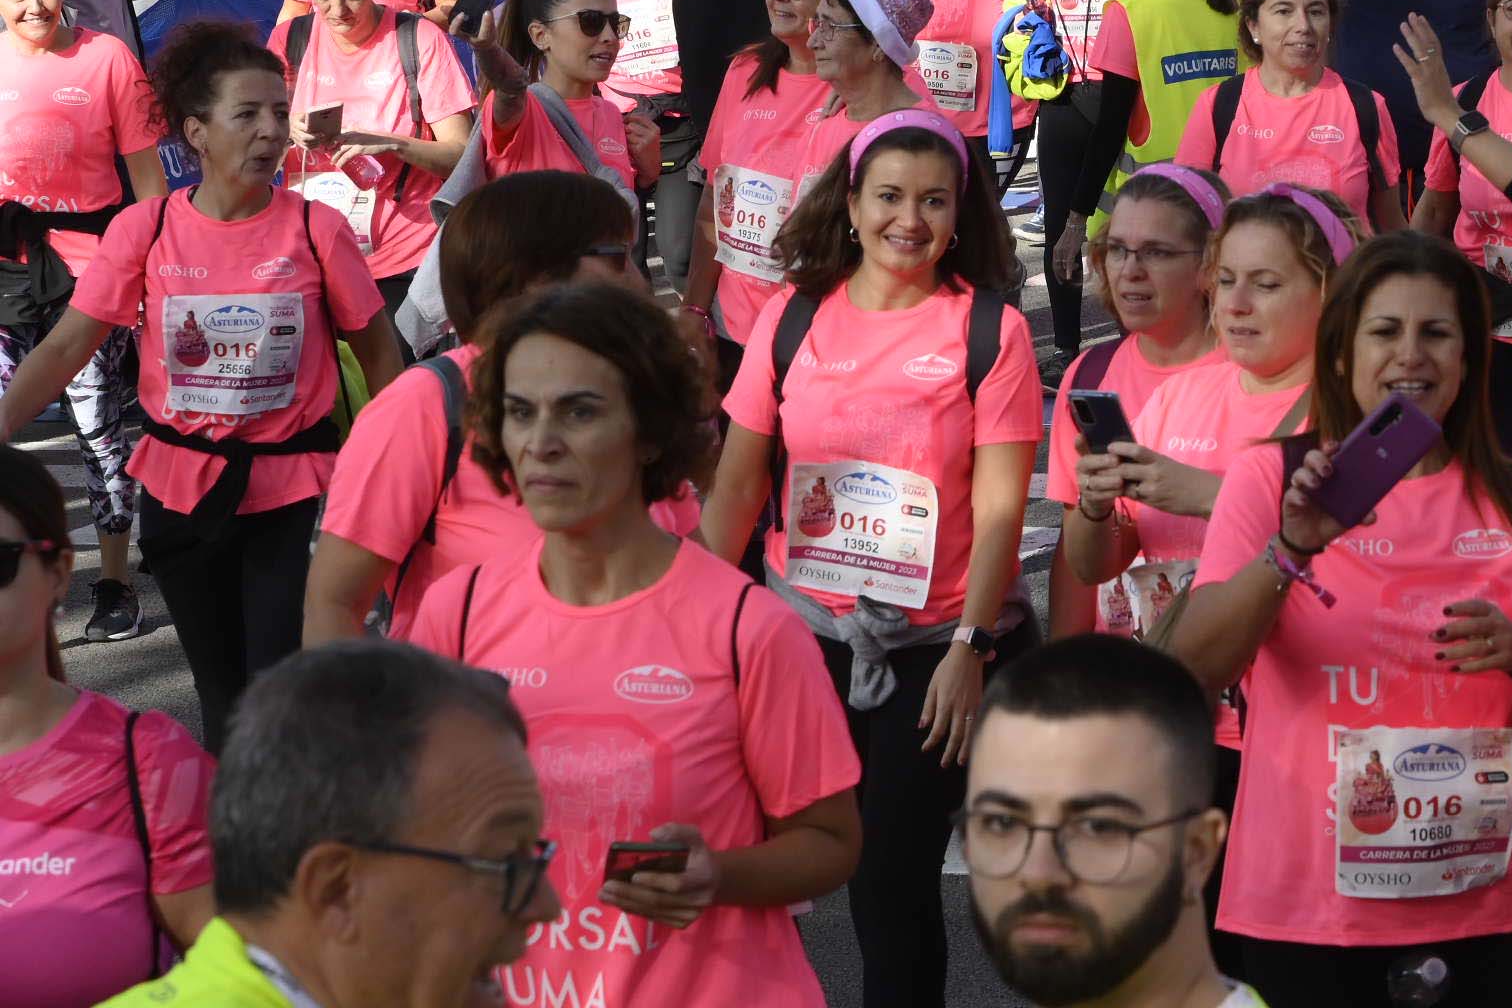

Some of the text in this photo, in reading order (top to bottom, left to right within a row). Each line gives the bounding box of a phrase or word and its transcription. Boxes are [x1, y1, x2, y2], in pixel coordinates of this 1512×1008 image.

[626, 28, 652, 42] 016
[923, 68, 950, 81] 016
[736, 208, 767, 230] 016
[1469, 209, 1502, 229] TU
[737, 228, 761, 242] 19375
[269, 309, 296, 318] SUMA
[208, 316, 261, 328] ASTURIANA
[213, 342, 258, 359] 016
[218, 363, 252, 375] 25656
[907, 363, 954, 376] ASTURIANA
[185, 377, 220, 387] CARRERA
[220, 378, 231, 387] DE
[231, 379, 241, 387] LA
[181, 392, 219, 406] OYSHO
[840, 483, 893, 501] ASTURIANA
[901, 487, 928, 498] SUMA
[839, 511, 887, 537] 016
[843, 536, 880, 554] 13952
[803, 548, 844, 564] CARRERA
[844, 555, 856, 565] DE
[856, 557, 868, 567] LA
[869, 559, 897, 572] MUJER
[799, 565, 842, 583] OYSHO
[875, 578, 918, 595] Santander
[616, 676, 693, 698] ASTURIANA
[1320, 664, 1380, 706] TU
[1471, 749, 1504, 761] SUMA
[1399, 759, 1462, 773] ASTURIANA
[1403, 794, 1463, 820] 016
[1409, 824, 1453, 842] 10680
[1359, 849, 1411, 860] CARRERA
[1412, 848, 1429, 859] DE
[1430, 847, 1442, 858] LA
[1353, 872, 1412, 887] OYSHO
